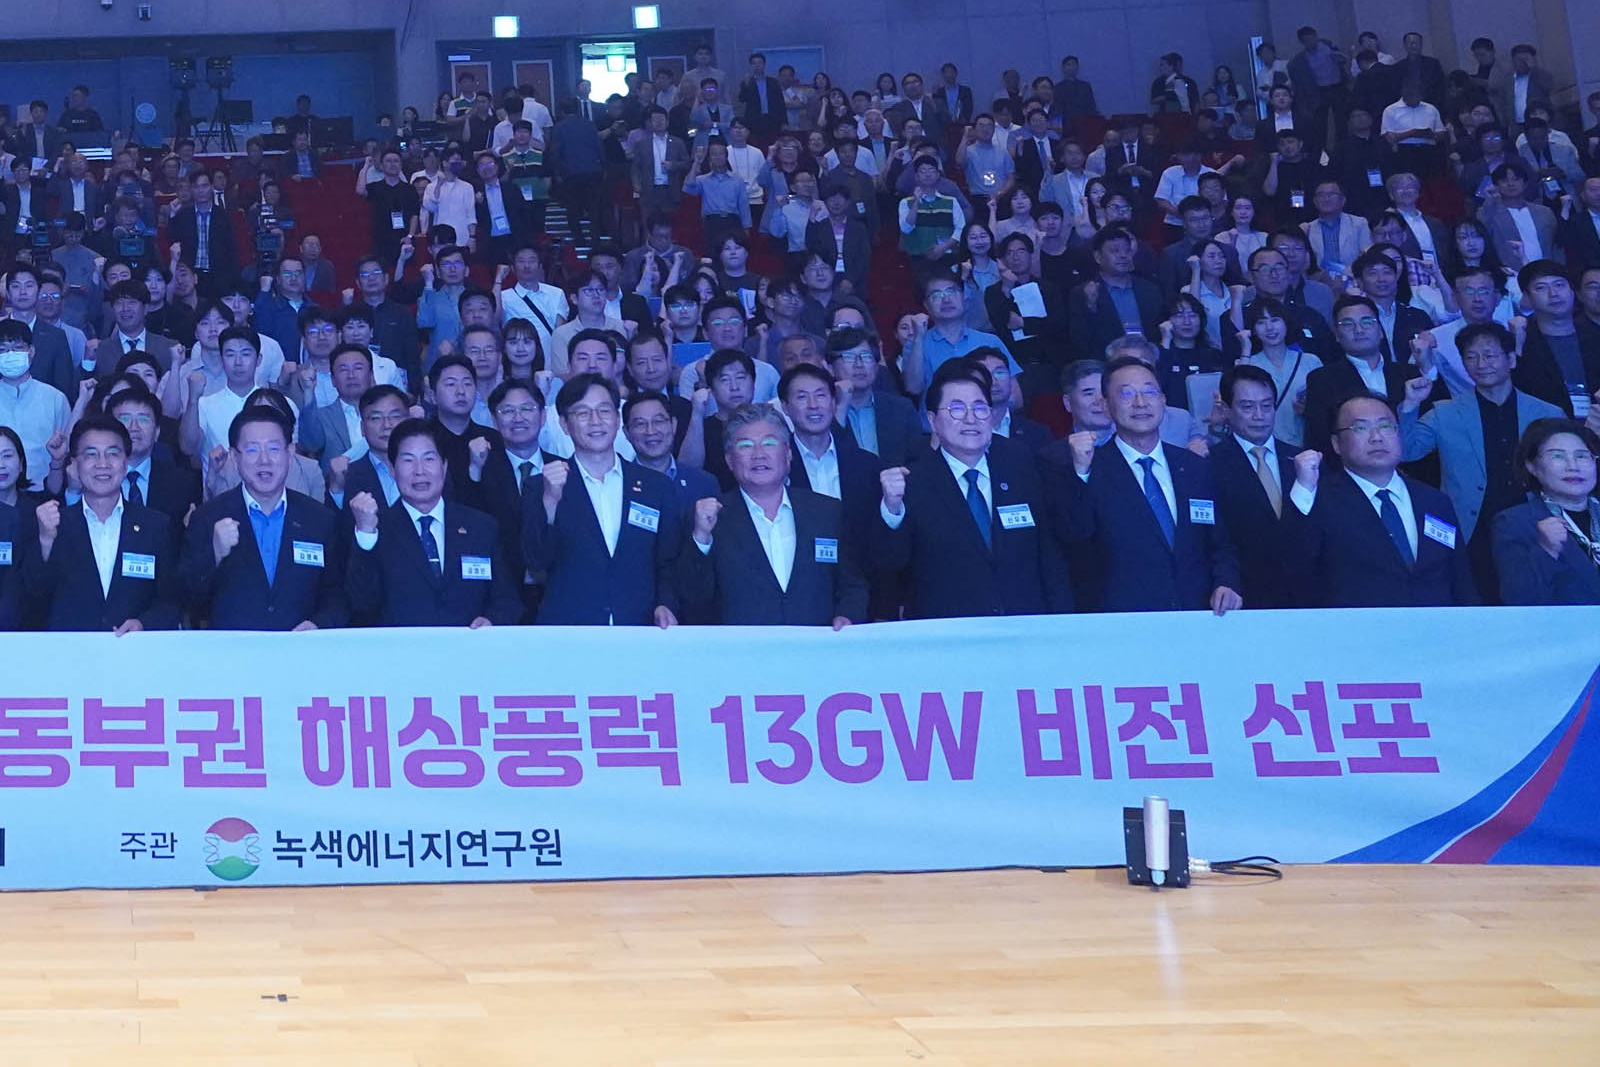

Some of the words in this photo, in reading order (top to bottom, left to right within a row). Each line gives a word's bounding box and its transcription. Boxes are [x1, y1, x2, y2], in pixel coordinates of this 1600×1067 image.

[297, 693, 681, 788] 해상풍력
[710, 691, 984, 785] 13GW
[1016, 683, 1214, 780] 비전
[1243, 681, 1440, 777] 선포
[120, 832, 178, 860] 주관
[272, 829, 562, 868] 녹색에너지연구원
